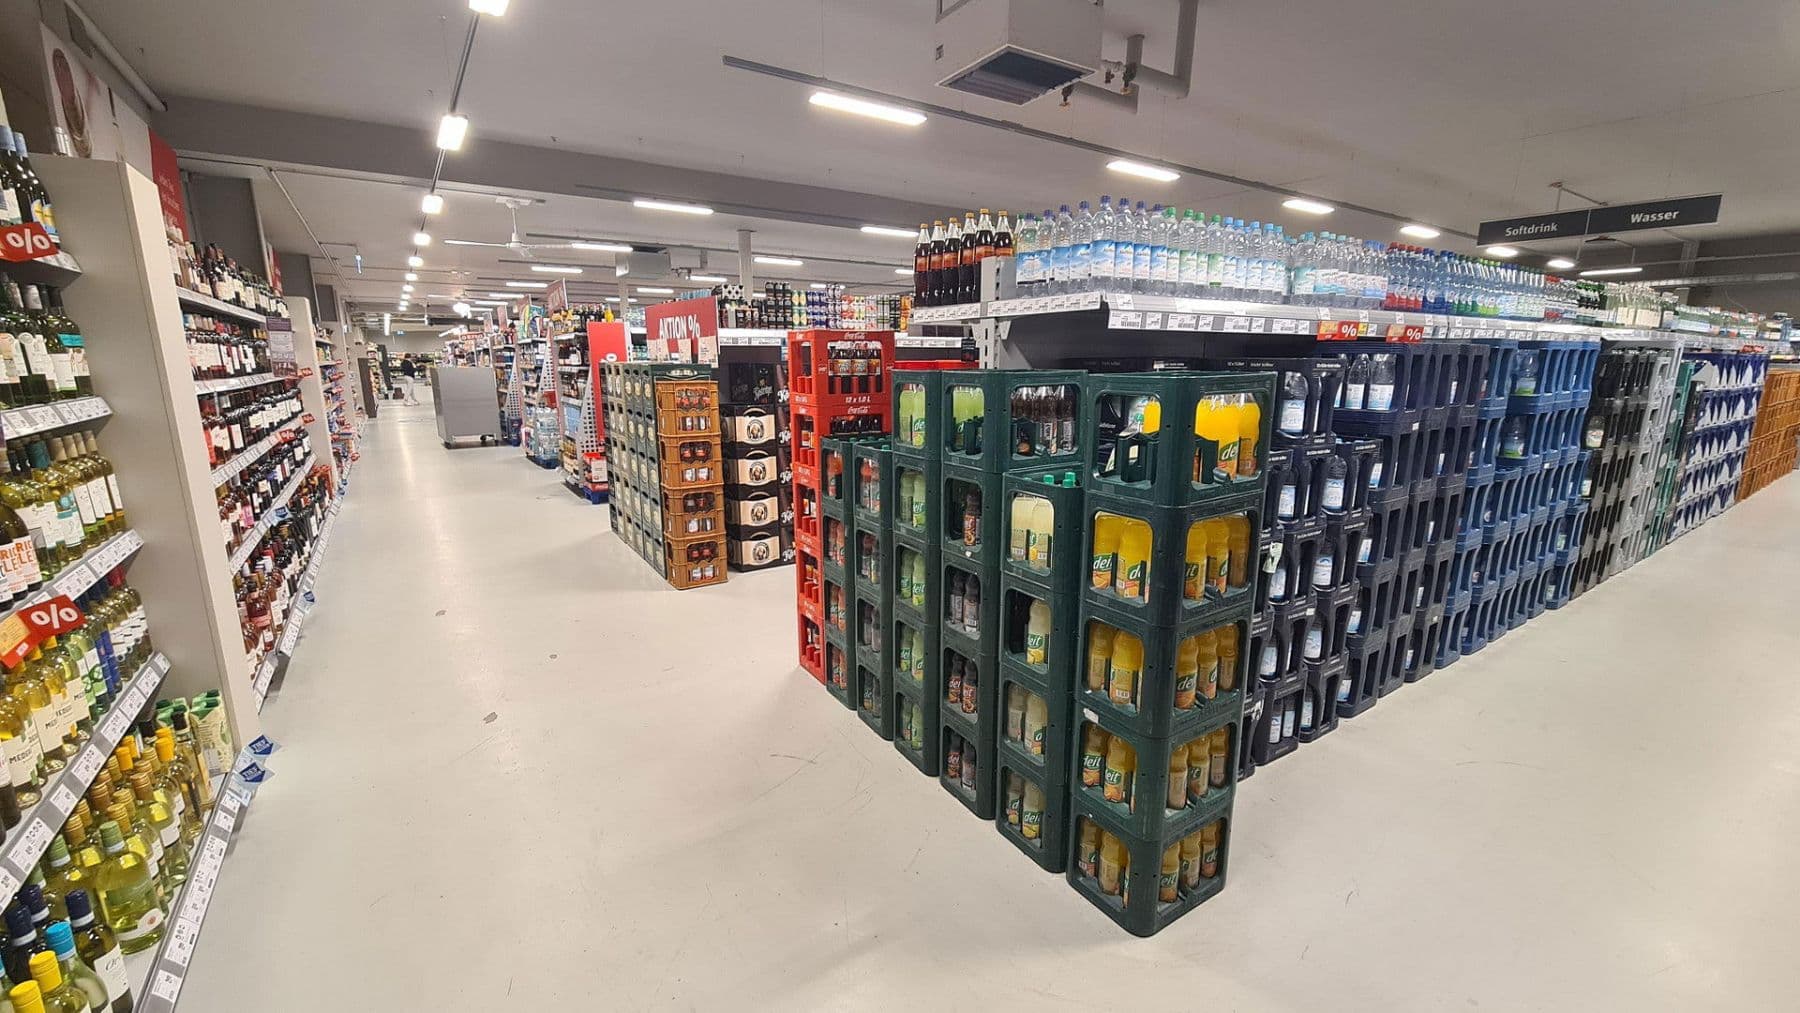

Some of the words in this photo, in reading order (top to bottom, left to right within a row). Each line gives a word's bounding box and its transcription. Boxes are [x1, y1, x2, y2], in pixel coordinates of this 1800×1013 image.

[1505, 222, 1558, 237] Softdrink
[1630, 209, 1679, 224] Wasser
[659, 316, 687, 339] AKTION
[1222, 444, 1238, 460] de
